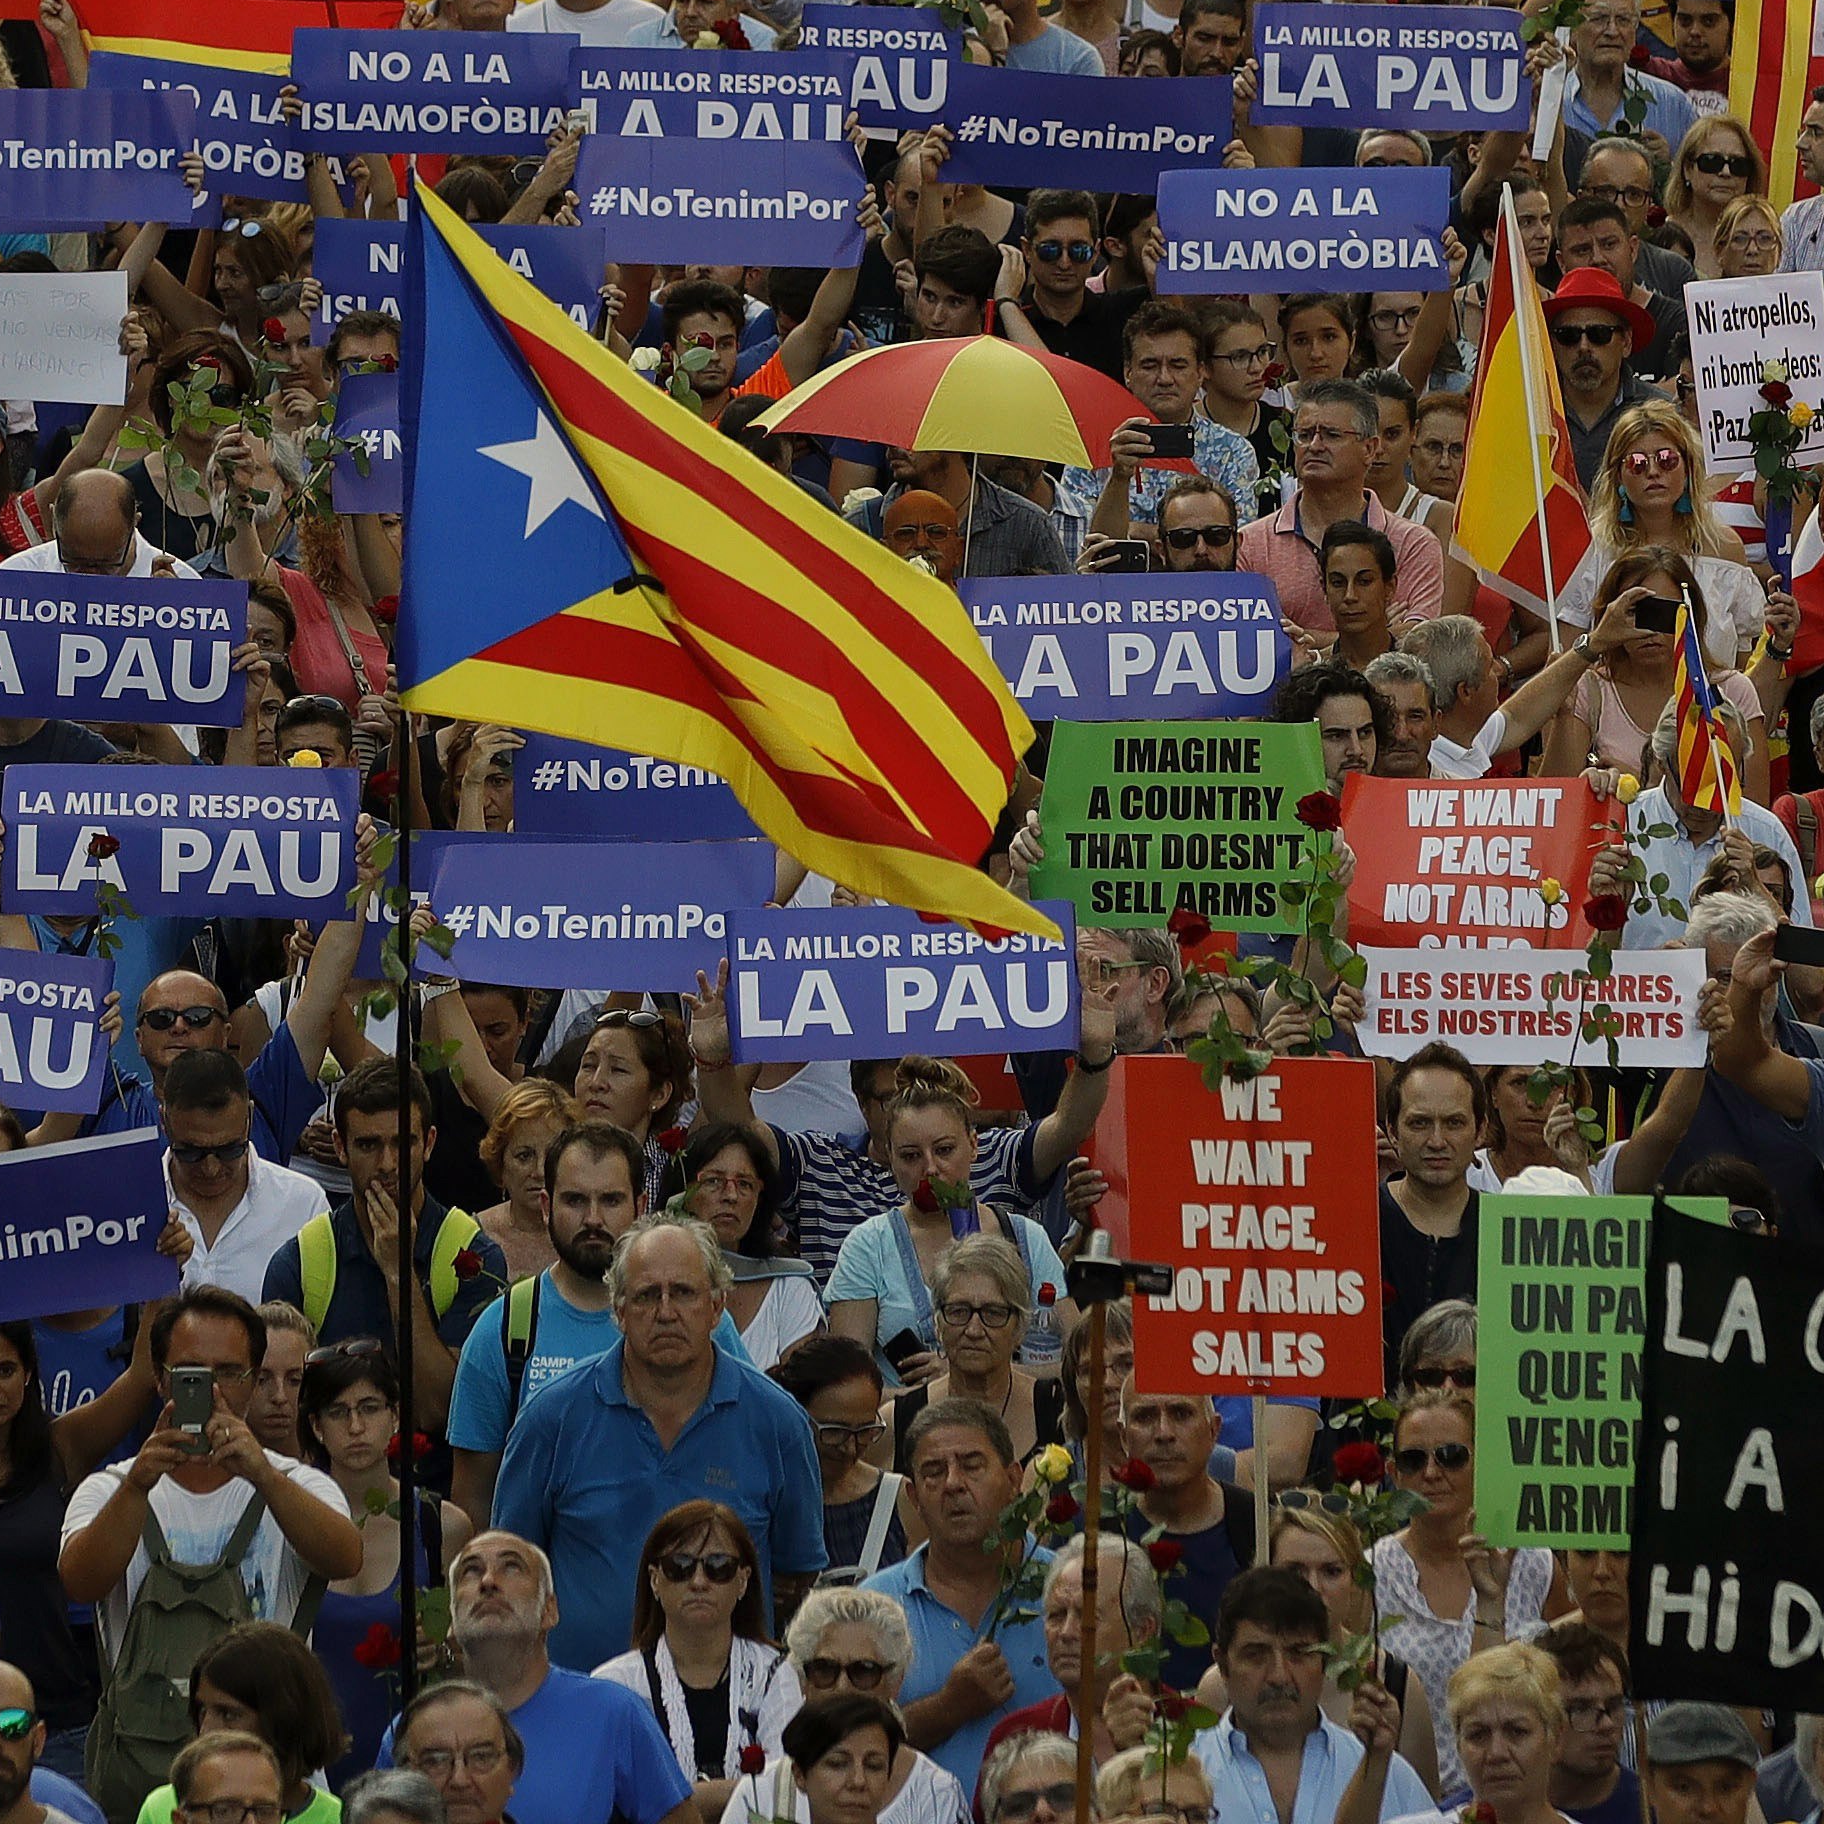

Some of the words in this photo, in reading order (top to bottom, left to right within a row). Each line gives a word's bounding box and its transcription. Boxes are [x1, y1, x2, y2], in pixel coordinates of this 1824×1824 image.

[956, 113, 1216, 156] #NoTenimPor
[1214, 187, 1279, 218] NO
[1291, 188, 1321, 217] A
[1328, 188, 1380, 216] LA
[1167, 231, 1439, 273] ISLAMOFÒBIA
[1112, 738, 1261, 773] IMAGINE
[1087, 788, 1111, 822] A
[1117, 786, 1285, 822] COUNTRY
[1067, 835, 1150, 871] THAT
[1160, 834, 1306, 871] DOESN'T
[1090, 880, 1173, 917] SELL
[1181, 881, 1277, 919] ARMS
[1662, 1262, 1767, 1365] LA
[1724, 1427, 1785, 1515] A
